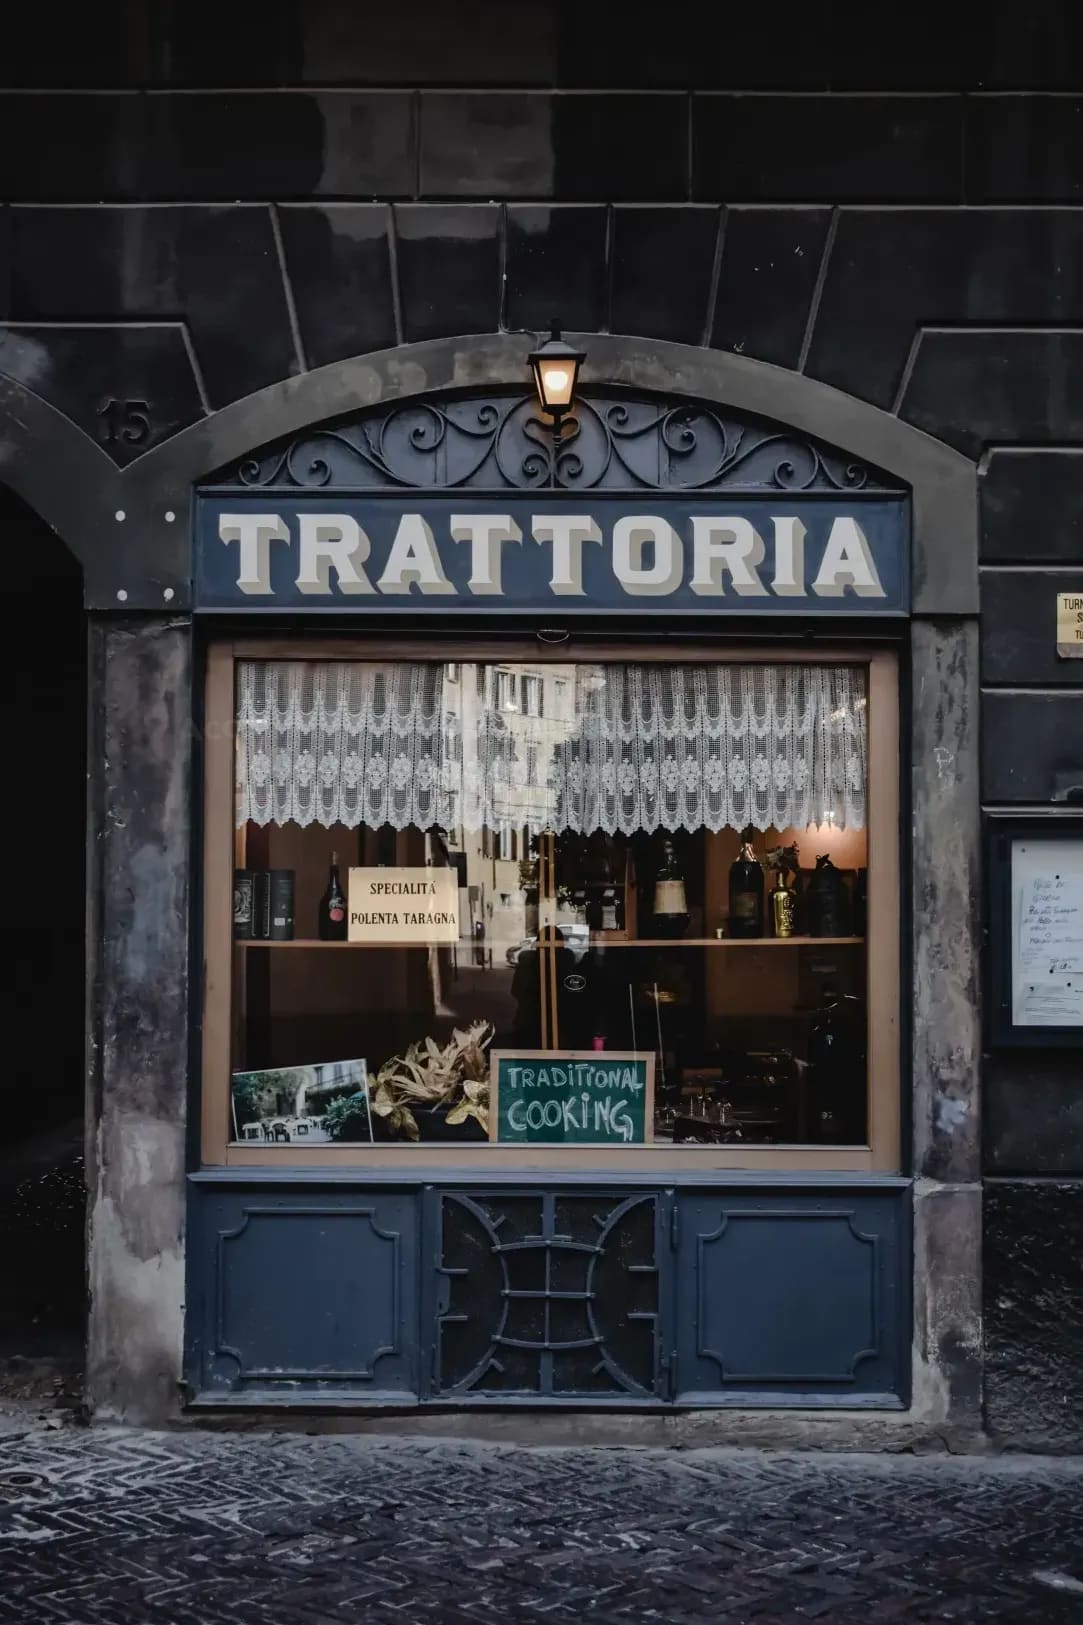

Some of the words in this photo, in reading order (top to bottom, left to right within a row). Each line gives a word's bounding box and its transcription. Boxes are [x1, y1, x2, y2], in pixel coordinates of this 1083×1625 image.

[97, 399, 151, 446] 15
[219, 513, 888, 598] TRATTORIA
[351, 912, 399, 925] POLENTA
[403, 912, 456, 925] TARAGNA
